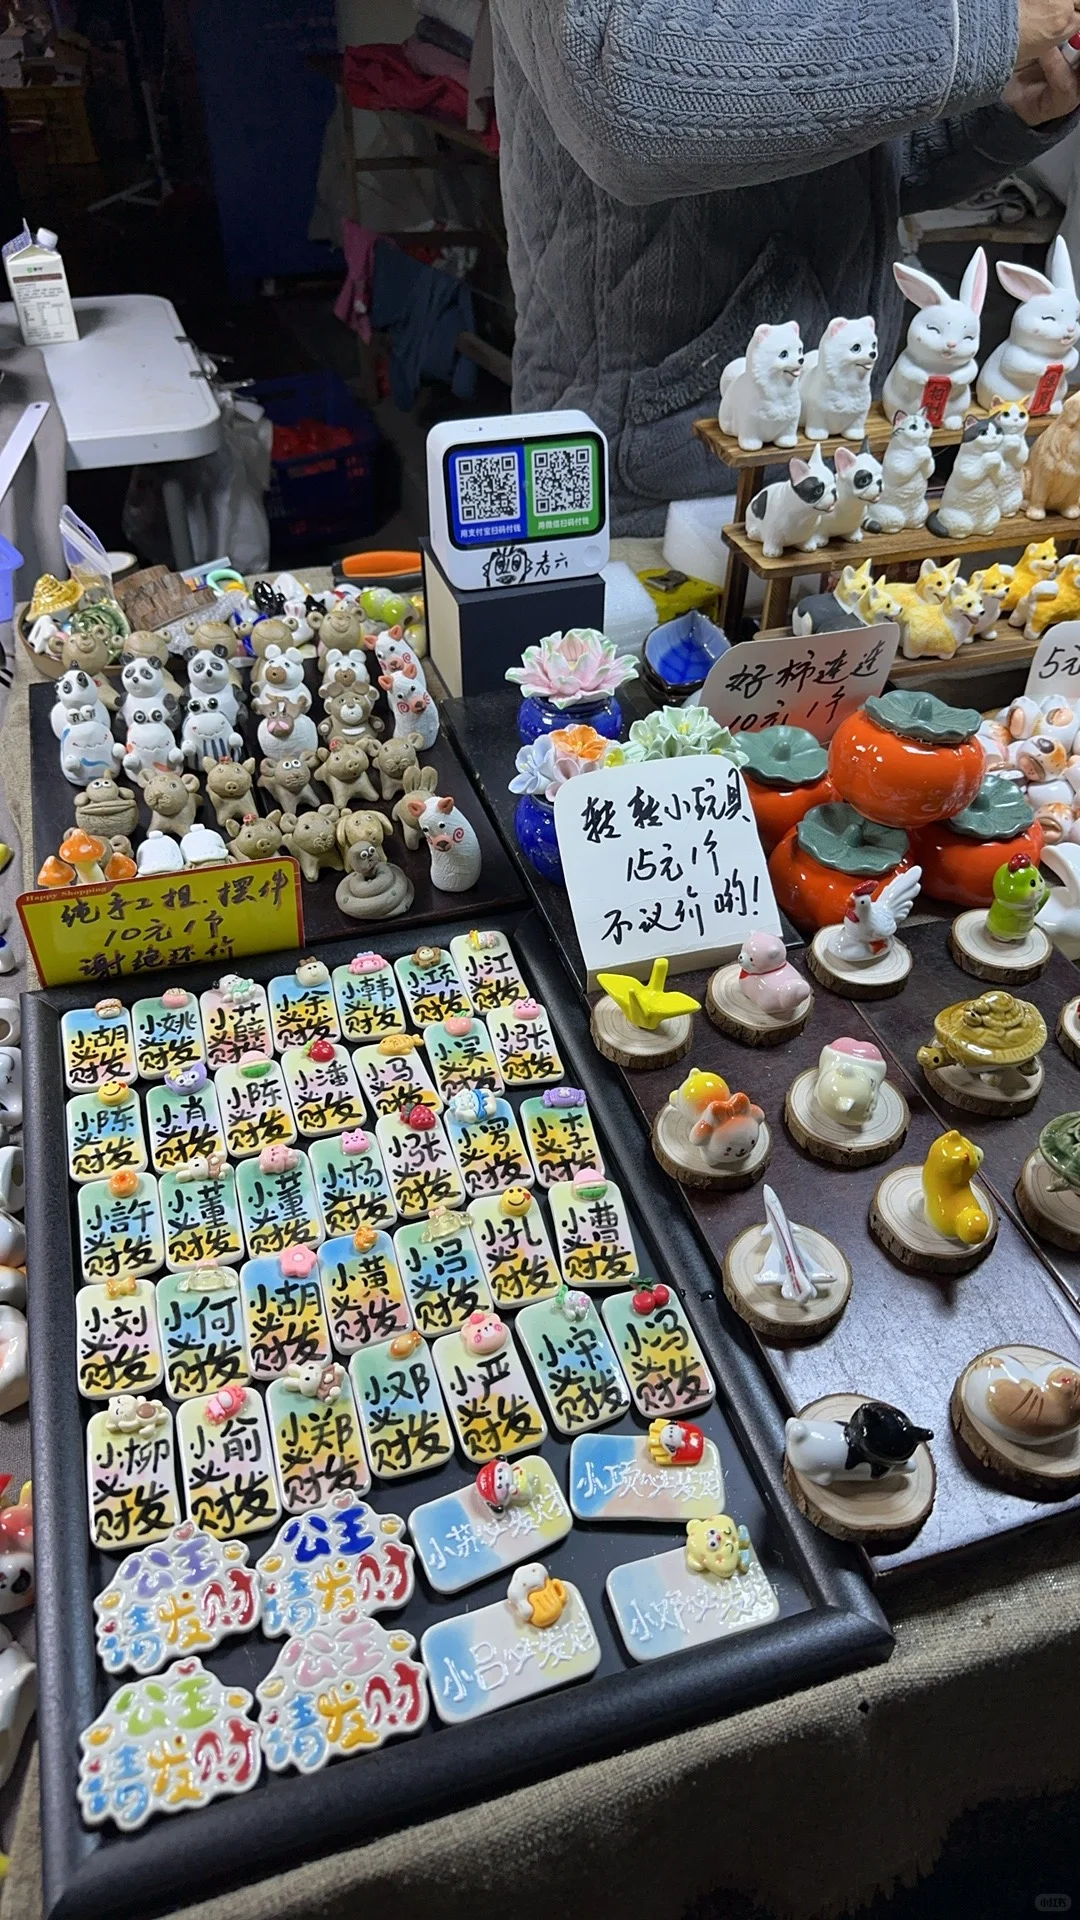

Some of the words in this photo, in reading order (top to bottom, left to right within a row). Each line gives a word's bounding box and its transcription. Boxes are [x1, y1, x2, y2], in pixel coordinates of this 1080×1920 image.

[460, 523, 521, 538] 用支付宝扫码付钱
[538, 516, 589, 530] 用微信扫码付钱
[534, 550, 568, 577] 老六
[26, 893, 57, 901] Happy
[61, 887, 107, 896] Shopping
[465, 952, 508, 977] 小江
[276, 990, 329, 1015] 小余
[341, 976, 395, 1001] 小韩
[71, 1025, 129, 1049] 小胡
[496, 1023, 550, 1051] 小张
[295, 1060, 348, 1090] 小潘
[366, 1057, 414, 1082] 小马
[227, 1079, 282, 1109] 小陈
[75, 1105, 135, 1132] 小陈
[458, 1117, 510, 1151] 小罗
[532, 1112, 590, 1149] 小李
[389, 1132, 447, 1167] 小张
[322, 1156, 384, 1188] 小杨
[168, 1180, 226, 1229] 小董
[248, 1171, 307, 1220] 小董
[481, 1216, 543, 1247] 小孔
[561, 1200, 620, 1243] 小曹
[405, 1237, 468, 1275] 小吕
[332, 1255, 389, 1297] 小黄
[250, 1280, 323, 1317] 小胡
[84, 1305, 148, 1339] 小刘
[164, 1296, 238, 1339] 小何
[624, 1308, 690, 1356] 小冯
[365, 1362, 430, 1406] 小邓
[281, 1407, 354, 1455] 小郑
[96, 1438, 170, 1476] 小柳
[282, 1506, 376, 1563] 公主
[123, 1536, 218, 1599] 公主
[282, 1622, 384, 1688] 公主
[114, 1676, 218, 1737] 公主
